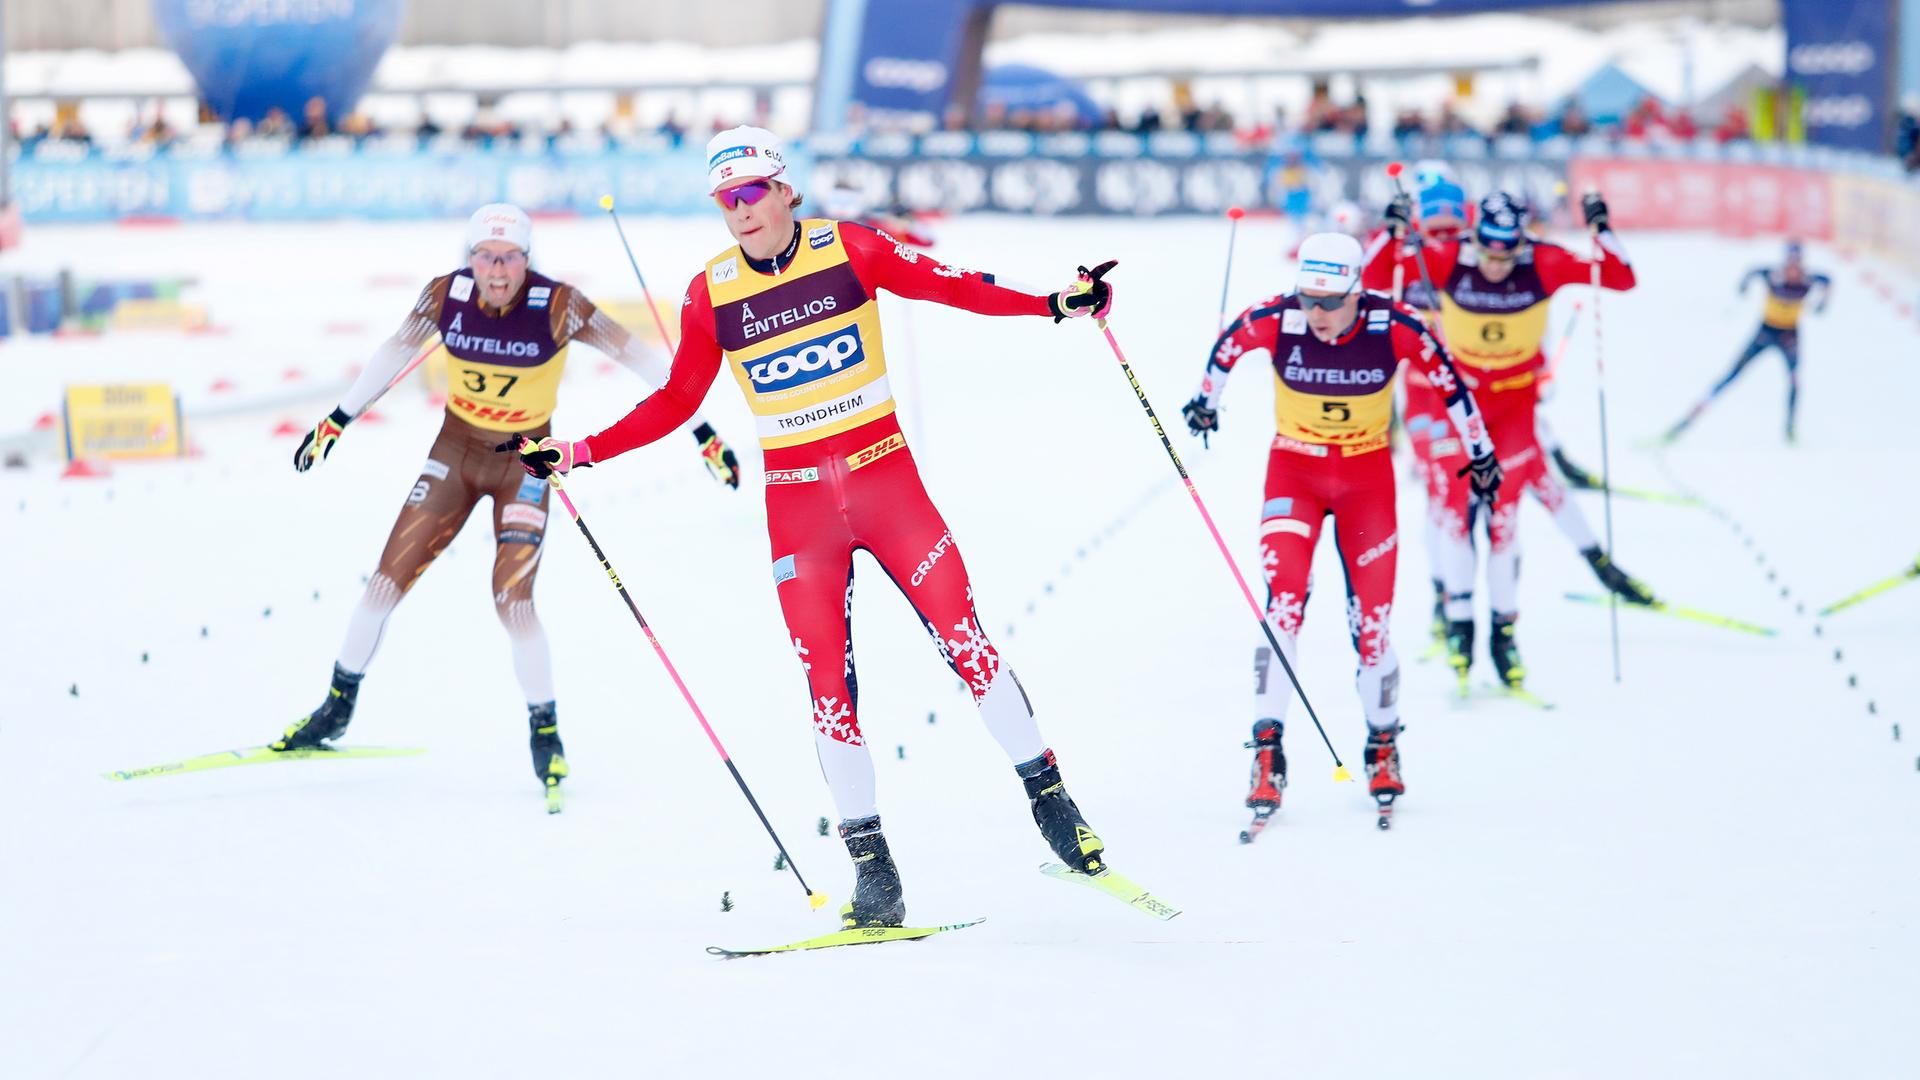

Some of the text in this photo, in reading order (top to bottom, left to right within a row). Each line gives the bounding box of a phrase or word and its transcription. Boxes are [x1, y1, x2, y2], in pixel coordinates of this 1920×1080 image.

[741, 303, 756, 323] Å
[743, 296, 837, 340] ENTELIOS
[445, 331, 541, 358] ENTELIOS
[750, 333, 859, 385] coop
[462, 369, 519, 398] 37
[1284, 365, 1386, 385] ENTELIOS
[778, 394, 864, 430] TRONDHEIM
[1321, 401, 1352, 423] 5
[857, 437, 899, 465] DHL
[765, 471, 803, 484] SPAR
